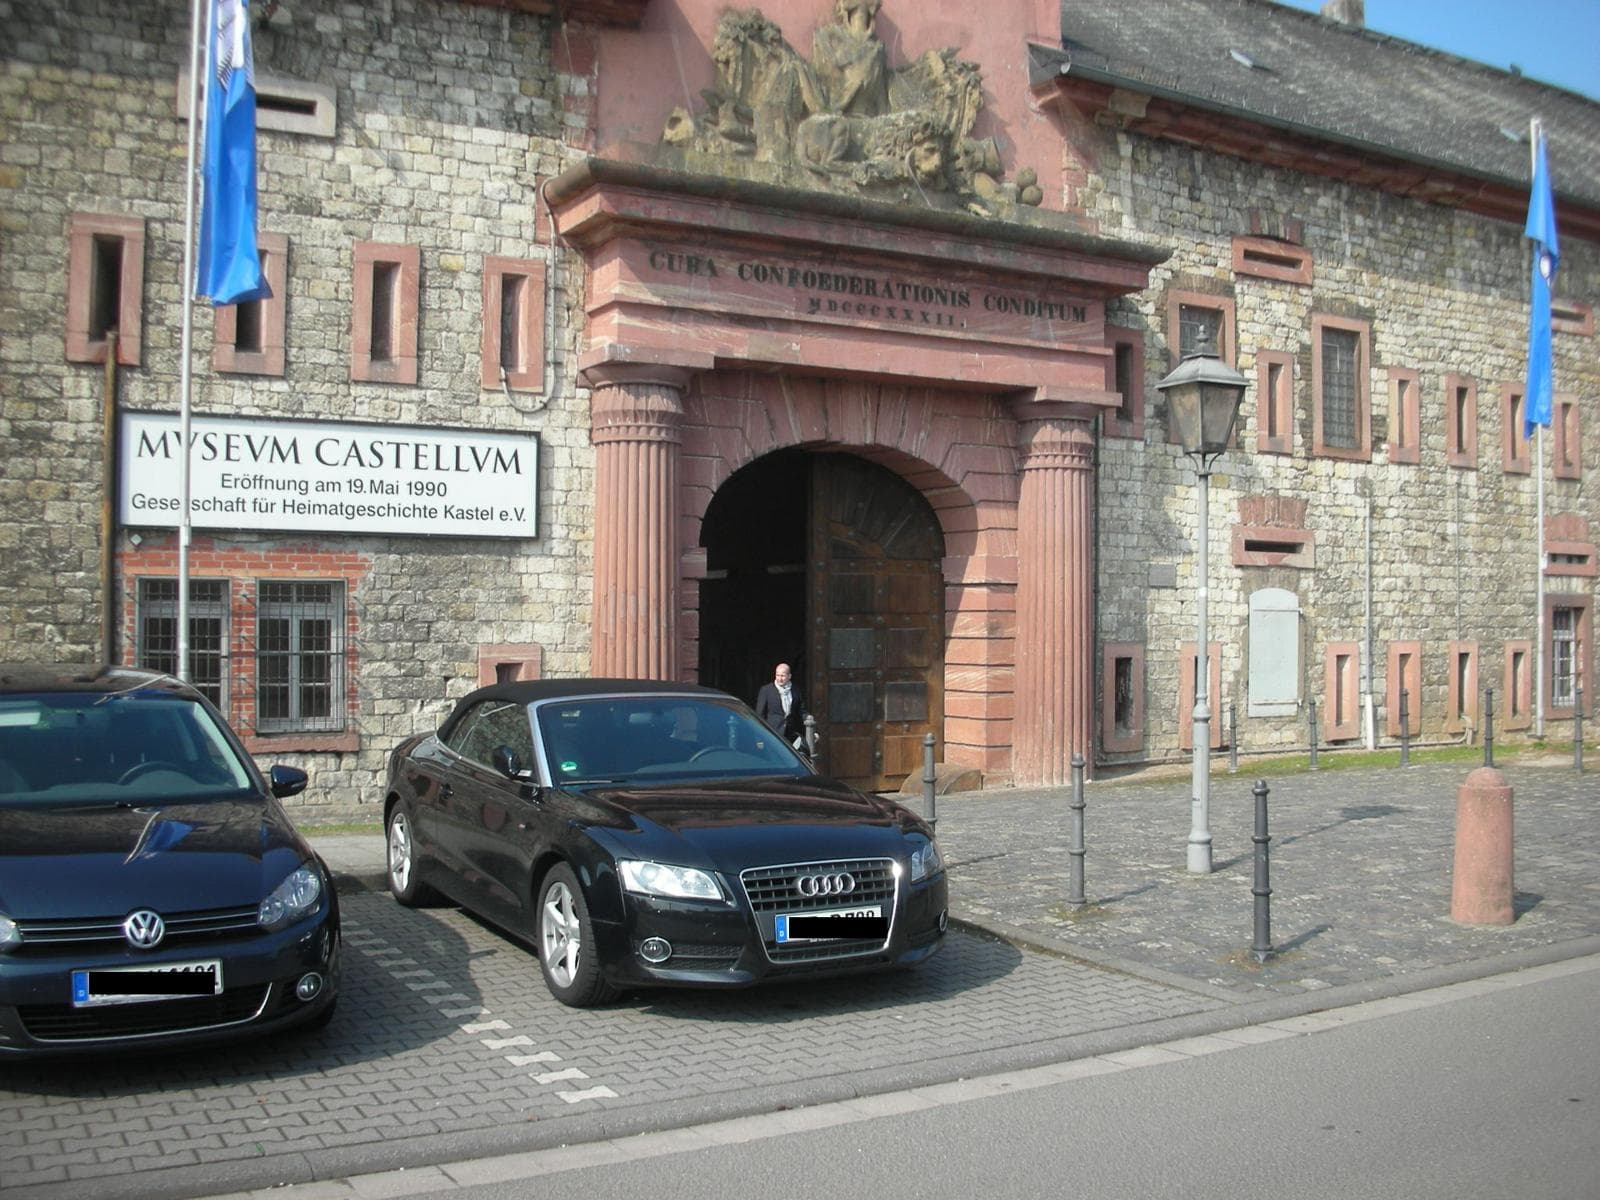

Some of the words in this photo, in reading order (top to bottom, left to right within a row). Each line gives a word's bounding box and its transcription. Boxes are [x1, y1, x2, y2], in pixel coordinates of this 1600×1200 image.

[983, 293, 1087, 323] CONDITUM
[137, 429, 302, 464] MVSEVM
[314, 438, 522, 475] CASTELLVM
[221, 473, 309, 495] Eröffnung
[315, 480, 341, 493] am
[406, 481, 447, 497] 1990
[131, 493, 246, 513] Geseschaft
[252, 498, 277, 513] für
[282, 499, 438, 520] Heimatgeschichte
[444, 505, 494, 521] Kastel
[499, 508, 527, 522] e.V.
